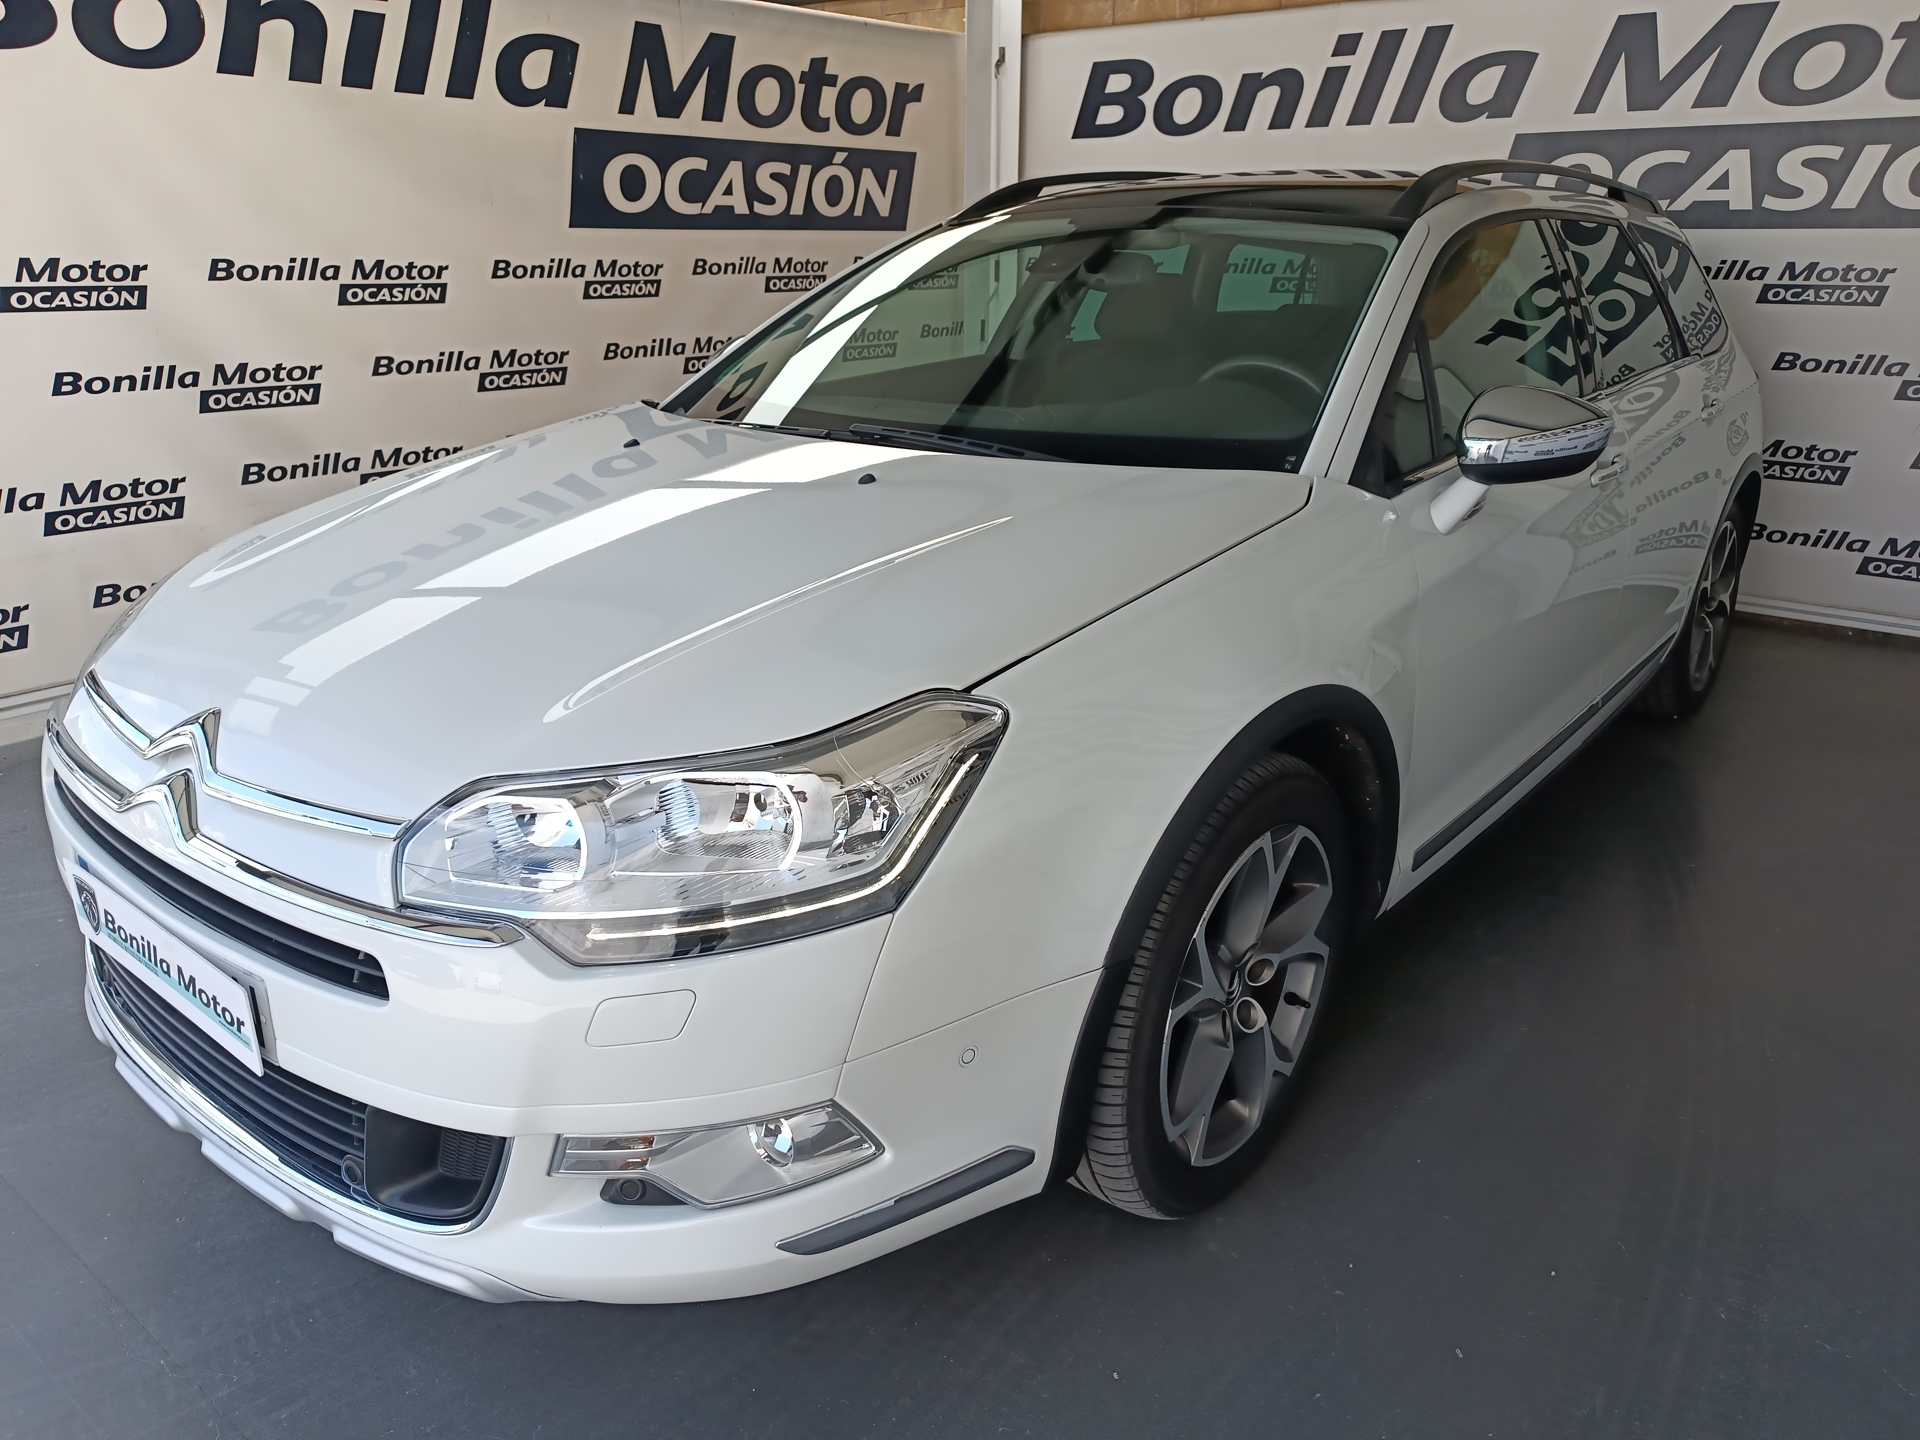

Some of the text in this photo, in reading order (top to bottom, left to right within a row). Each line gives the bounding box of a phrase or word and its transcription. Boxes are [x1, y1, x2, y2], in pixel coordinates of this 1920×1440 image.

[617, 20, 925, 138] Motor
[1071, 23, 1540, 140] Bonilla
[602, 151, 898, 218] OCASIÓN
[14, 257, 149, 283] Motor
[207, 257, 450, 282] Bonilla Motor
[490, 257, 664, 280] Bonilla Motor
[691, 256, 829, 276] Bonilla Motor
[1226, 257, 1277, 275] nilla
[1702, 259, 1898, 283] illa Motor
[346, 284, 442, 303] OCASIÓN
[588, 280, 658, 298] OCASIÓN
[769, 276, 824, 291] OCASIÓN
[1766, 286, 1880, 303] OCASIÓN
[10, 287, 140, 309] OCASIÓN
[850, 327, 899, 344] Motor
[920, 321, 965, 339] Bonill
[602, 337, 687, 361] Bonilla
[846, 345, 894, 360] OCASIÓN
[370, 348, 570, 377] Bonilla Motor
[1770, 351, 1911, 378] Bonilla
[51, 361, 323, 397] Bonilla Motor
[483, 369, 563, 391] OCASIÓN
[208, 386, 314, 410] OCASIÓN
[240, 451, 361, 486] Bonilla
[1763, 464, 1842, 483] ASIÓN
[59, 476, 187, 507] Motor
[54, 500, 178, 532] OCASIÓN
[1750, 522, 1871, 554] Bonilla
[1867, 561, 1920, 579] OCA
[103, 907, 172, 979] Bonilla
[176, 964, 246, 1035] Motor
